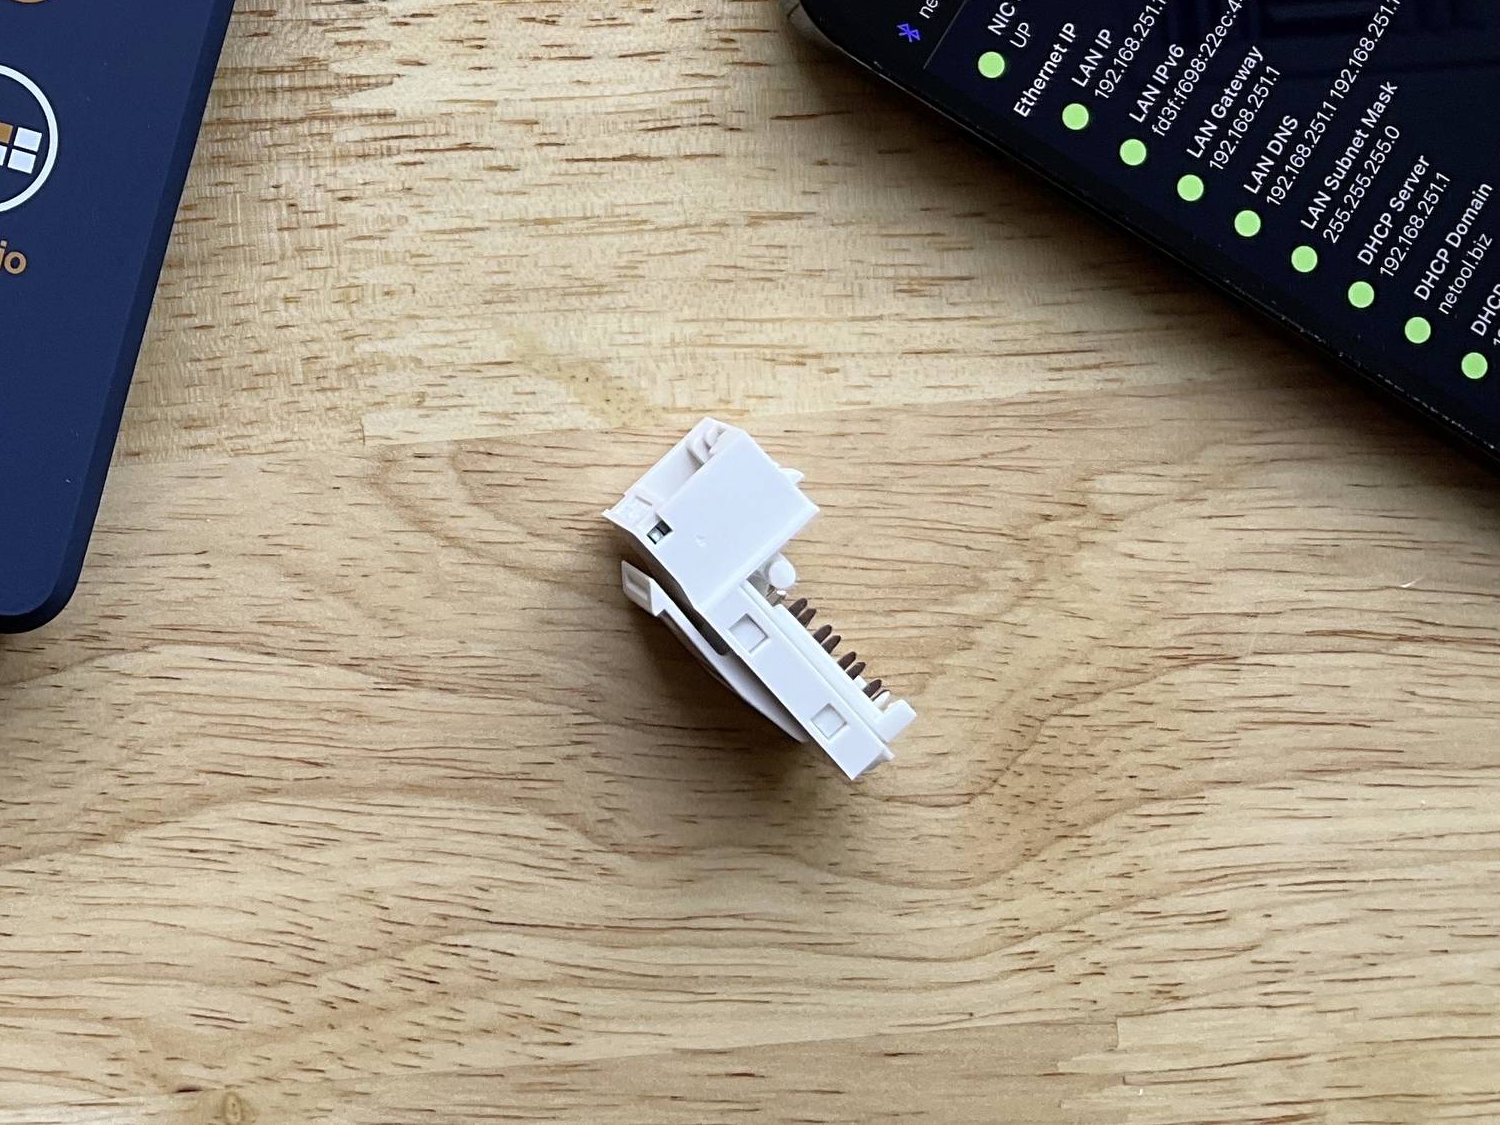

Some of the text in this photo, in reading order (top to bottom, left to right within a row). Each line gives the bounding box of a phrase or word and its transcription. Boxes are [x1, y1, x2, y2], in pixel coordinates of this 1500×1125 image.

[987, 1, 1016, 36] NIC
[1009, 22, 1031, 48] UP
[1013, 22, 1076, 118] Ethernet IP
[1071, 28, 1112, 88] LAN IP
[1128, 43, 1185, 123] LAN IPv6
[1186, 45, 1264, 159] LAN Gateway
[1209, 65, 1281, 170] 192.168.251.1
[1243, 115, 1299, 194] LAN DNS
[1266, 101, 1337, 206] 192.168.251.1
[1300, 81, 1398, 230] LAN Subnet Mask
[1322, 125, 1400, 244] 255.255.255.0
[1356, 154, 1430, 266] DHCP Server
[1379, 172, 1451, 277] 192.168.251.1
[1413, 183, 1493, 301] DHCP Domain
[1438, 233, 1493, 315] netool.biz
